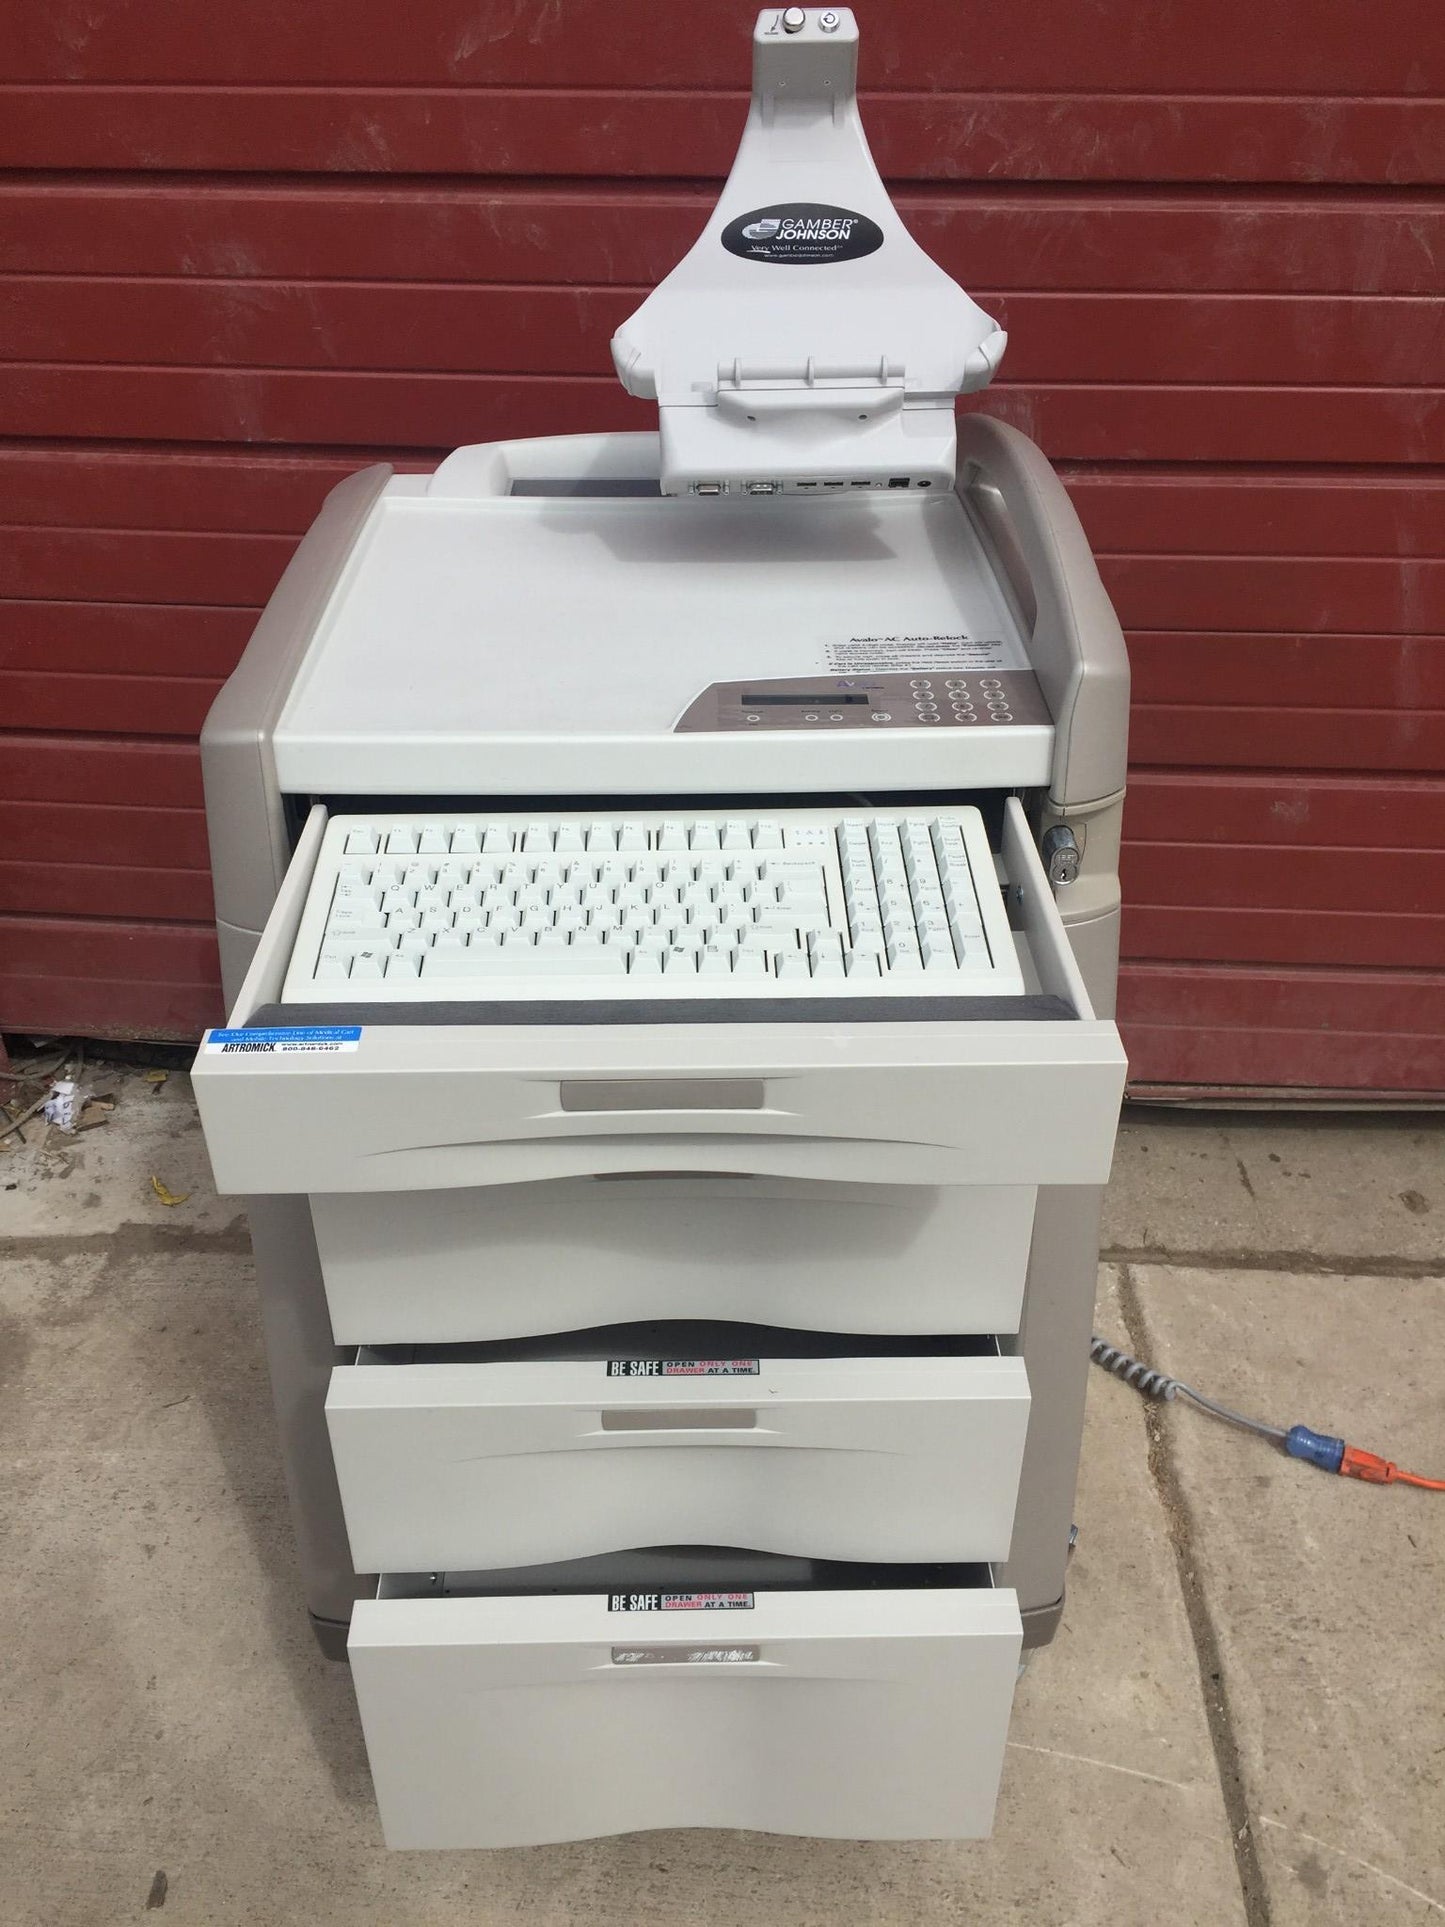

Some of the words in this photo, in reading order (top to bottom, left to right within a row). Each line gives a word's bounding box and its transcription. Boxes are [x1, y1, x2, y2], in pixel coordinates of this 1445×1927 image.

[776, 229, 850, 240] JOHNSON
[221, 1042, 276, 1053] ARTROMICK
[611, 1361, 626, 1376] BE
[630, 1361, 659, 1376] SAFE
[612, 1595, 626, 1611] BE
[630, 1595, 658, 1610] SAFE
